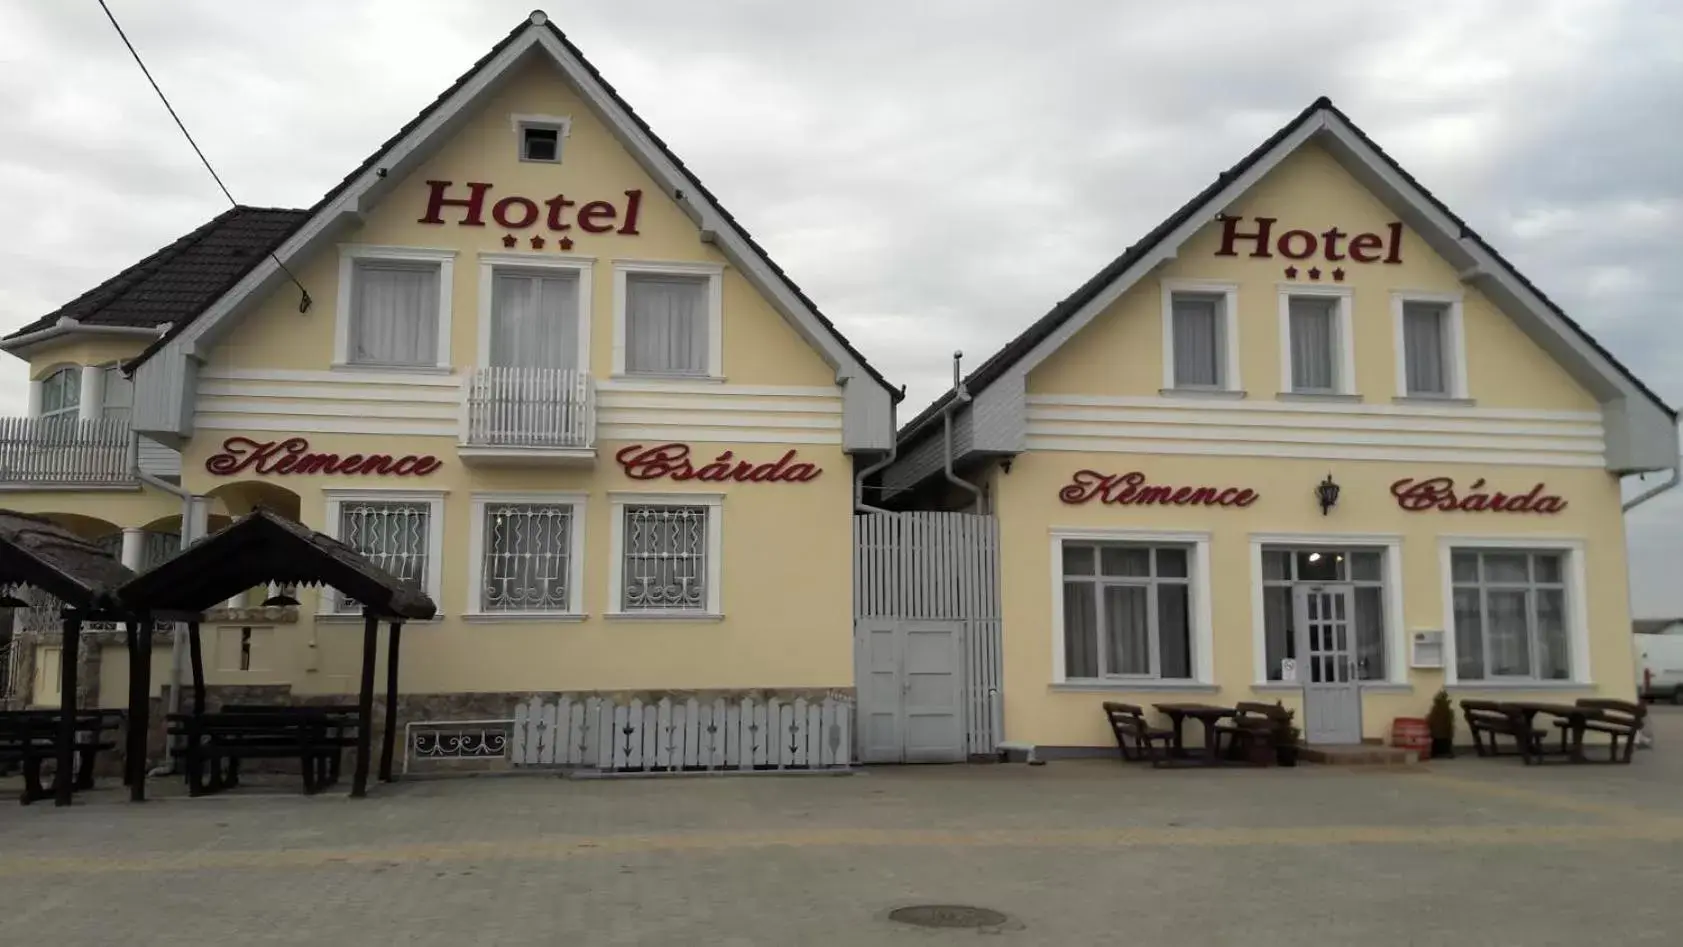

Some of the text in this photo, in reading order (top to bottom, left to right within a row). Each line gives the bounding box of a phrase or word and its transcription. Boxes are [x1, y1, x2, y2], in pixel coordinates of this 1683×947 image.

[417, 179, 642, 236] Hotel
[1214, 215, 1403, 264] Hotel
[615, 443, 823, 483] Csárda
[1390, 477, 1568, 513] Csárda
